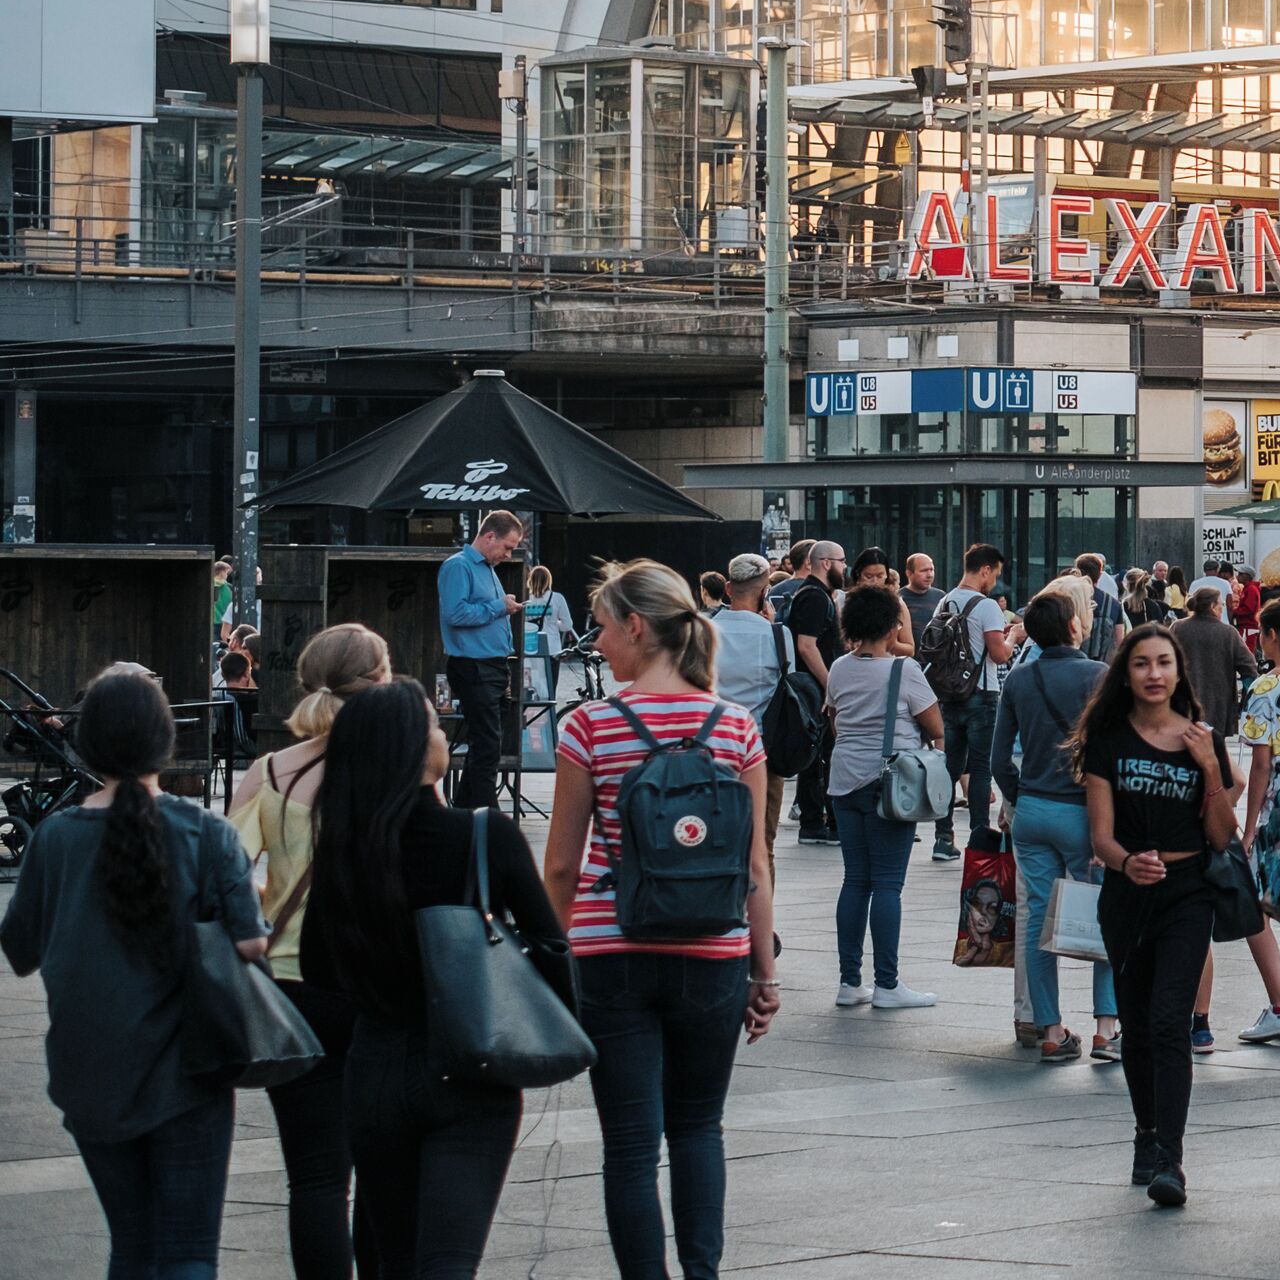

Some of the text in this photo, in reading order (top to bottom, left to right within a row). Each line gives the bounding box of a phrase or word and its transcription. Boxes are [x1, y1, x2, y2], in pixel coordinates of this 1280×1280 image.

[862, 378, 876, 390] U8
[1059, 376, 1077, 389] U8
[811, 377, 828, 413] U
[972, 372, 996, 408] U
[862, 396, 876, 410] U5
[1059, 395, 1077, 408] U5
[1035, 465, 1131, 480] U Alexanderplatz
[420, 483, 530, 501] Tchibo
[1224, 540, 1234, 551] IN
[1126, 759, 1198, 786] REGRET
